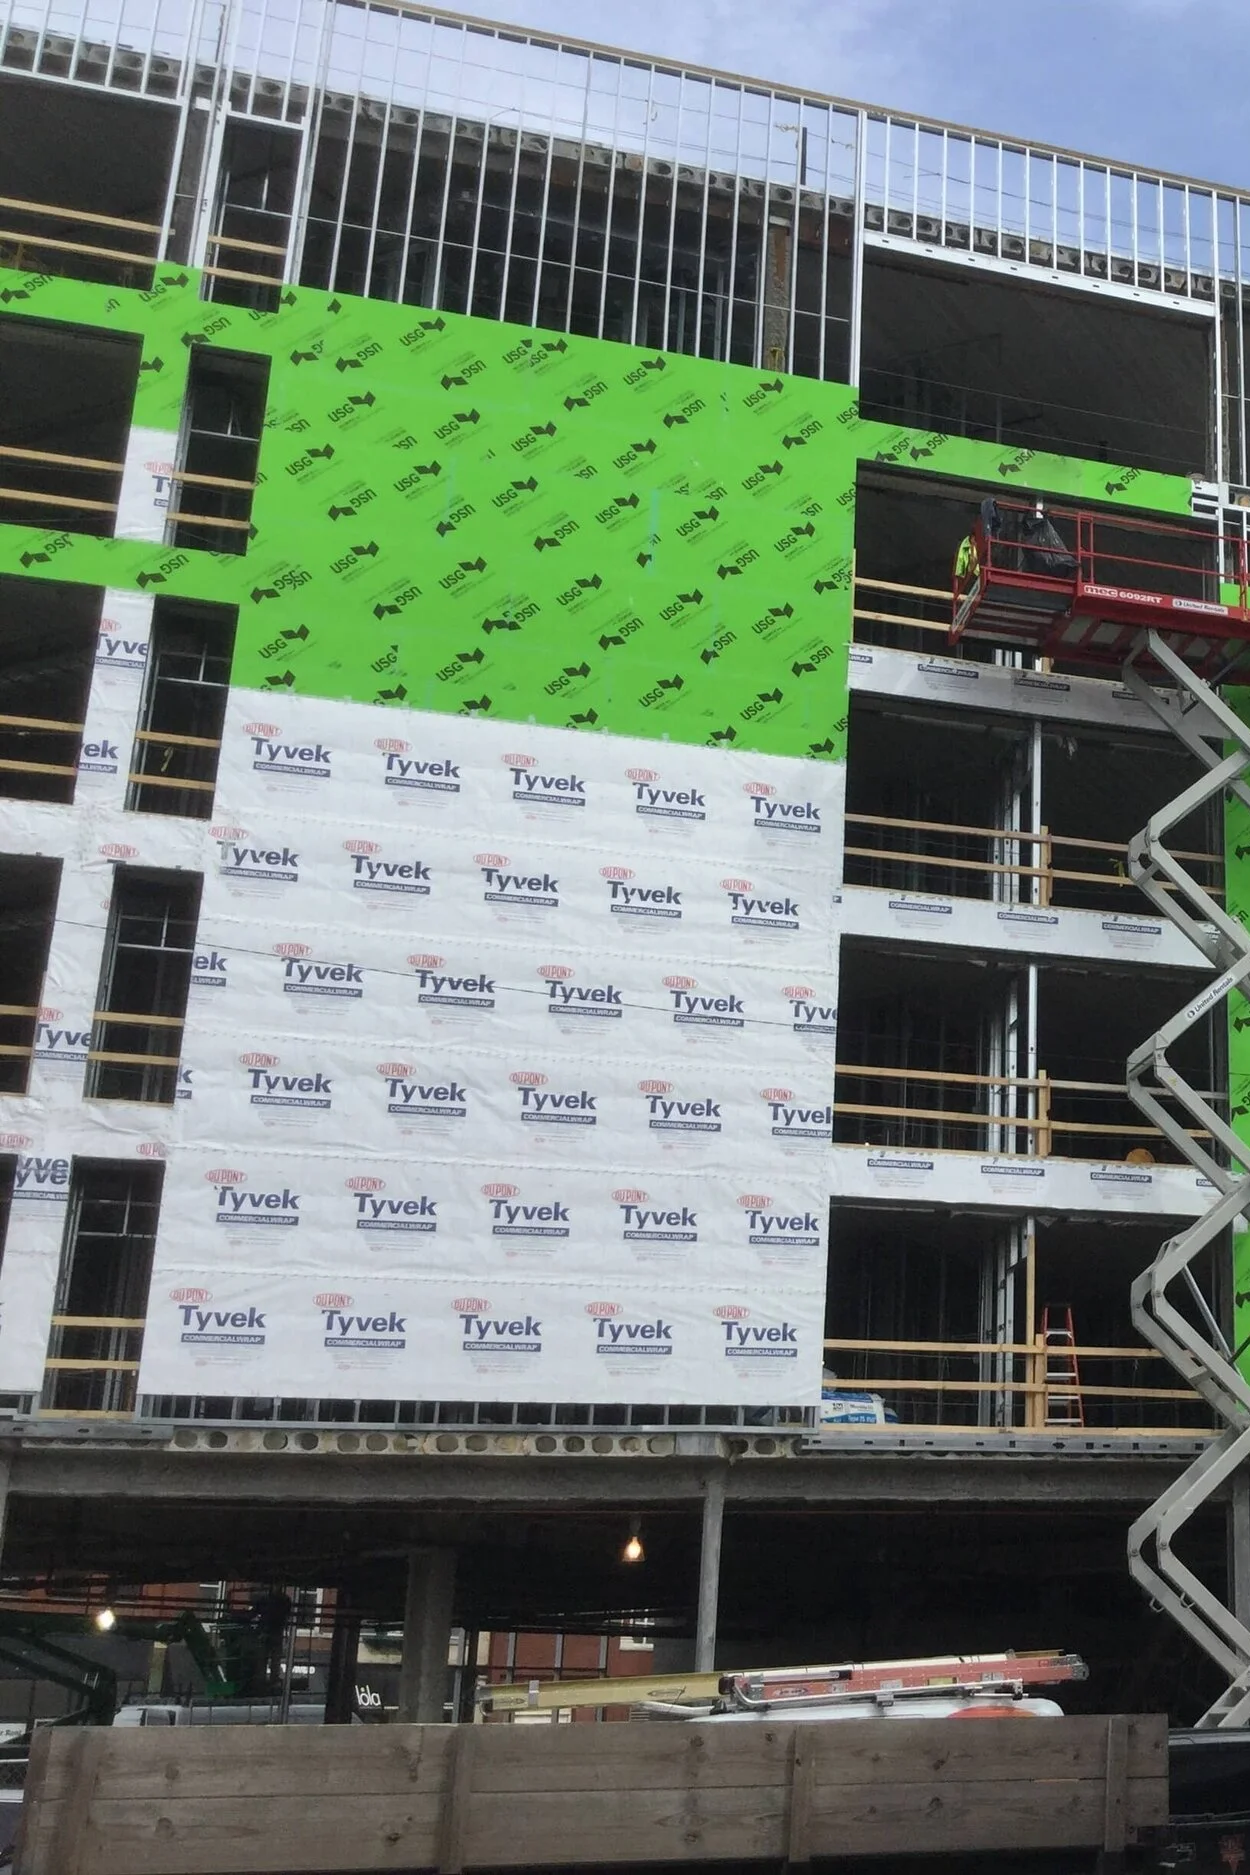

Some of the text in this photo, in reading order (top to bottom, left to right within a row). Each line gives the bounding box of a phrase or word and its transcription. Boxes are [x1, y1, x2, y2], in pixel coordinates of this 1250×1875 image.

[204, 316, 232, 337] USG
[400, 329, 426, 346] USG
[357, 342, 383, 361] USG
[502, 346, 528, 365] USG
[462, 360, 487, 378] USG
[623, 368, 647, 386] USG
[583, 381, 609, 399] USG
[742, 389, 766, 408] USG
[328, 404, 355, 423] USG
[682, 399, 706, 418] USG
[434, 421, 460, 440] USG
[800, 420, 823, 438] USG
[511, 434, 537, 452] USG
[285, 457, 313, 476] USG
[613, 450, 638, 470] USG
[393, 473, 420, 492] USG
[742, 472, 765, 492] USG
[350, 488, 378, 508] USG
[491, 489, 518, 508] USG
[449, 504, 476, 524] USG
[595, 505, 620, 525] USG
[554, 520, 580, 540] USG
[676, 518, 700, 538] USG
[774, 534, 798, 553] USG
[160, 554, 190, 574] USG
[330, 554, 358, 574] USG
[736, 549, 760, 568] USG
[439, 570, 466, 590] USG
[395, 586, 422, 606] USG
[556, 587, 582, 606] USG
[1119, 592, 1162, 604] 6092RT
[660, 602, 684, 621] USG
[619, 618, 644, 638] USG
[751, 616, 775, 635] USG
[258, 639, 288, 660] USG
[713, 631, 737, 651] USG
[810, 645, 833, 664] USG
[436, 661, 464, 682] USG
[544, 675, 570, 696] USG
[639, 688, 664, 708] USG
[740, 701, 764, 721] USG
[250, 736, 331, 764] Tyvek
[386, 752, 460, 779] Tyvek
[509, 767, 585, 793] Tyvek
[631, 782, 705, 807] Tyvek
[750, 795, 821, 820] Tyvek
[216, 840, 300, 868] Tyvek
[350, 854, 432, 881] Tyvek
[480, 867, 559, 893] Tyvek
[606, 880, 682, 905] Tyvek
[727, 892, 799, 917] Tyvek
[280, 956, 365, 984] Tyvek
[414, 968, 496, 994] Tyvek
[545, 979, 622, 1005] Tyvek
[669, 989, 744, 1015] Tyvek
[1194, 977, 1234, 1012] United Rentals
[247, 1067, 333, 1095] Tyvek
[384, 1077, 467, 1104] Tyvek
[517, 1086, 597, 1112] Tyvek
[644, 1094, 721, 1120] Tyvek
[213, 1185, 301, 1213] Tyvek
[353, 1192, 438, 1219] Tyvek
[488, 1198, 570, 1225] Tyvek
[619, 1204, 697, 1230] Tyvek
[744, 1209, 820, 1235] Tyvek
[178, 1304, 267, 1332] Tyvek
[321, 1309, 407, 1337] Tyvek
[458, 1313, 542, 1341] Tyvek
[592, 1317, 673, 1344] Tyvek
[720, 1320, 798, 1346] Tyvek
